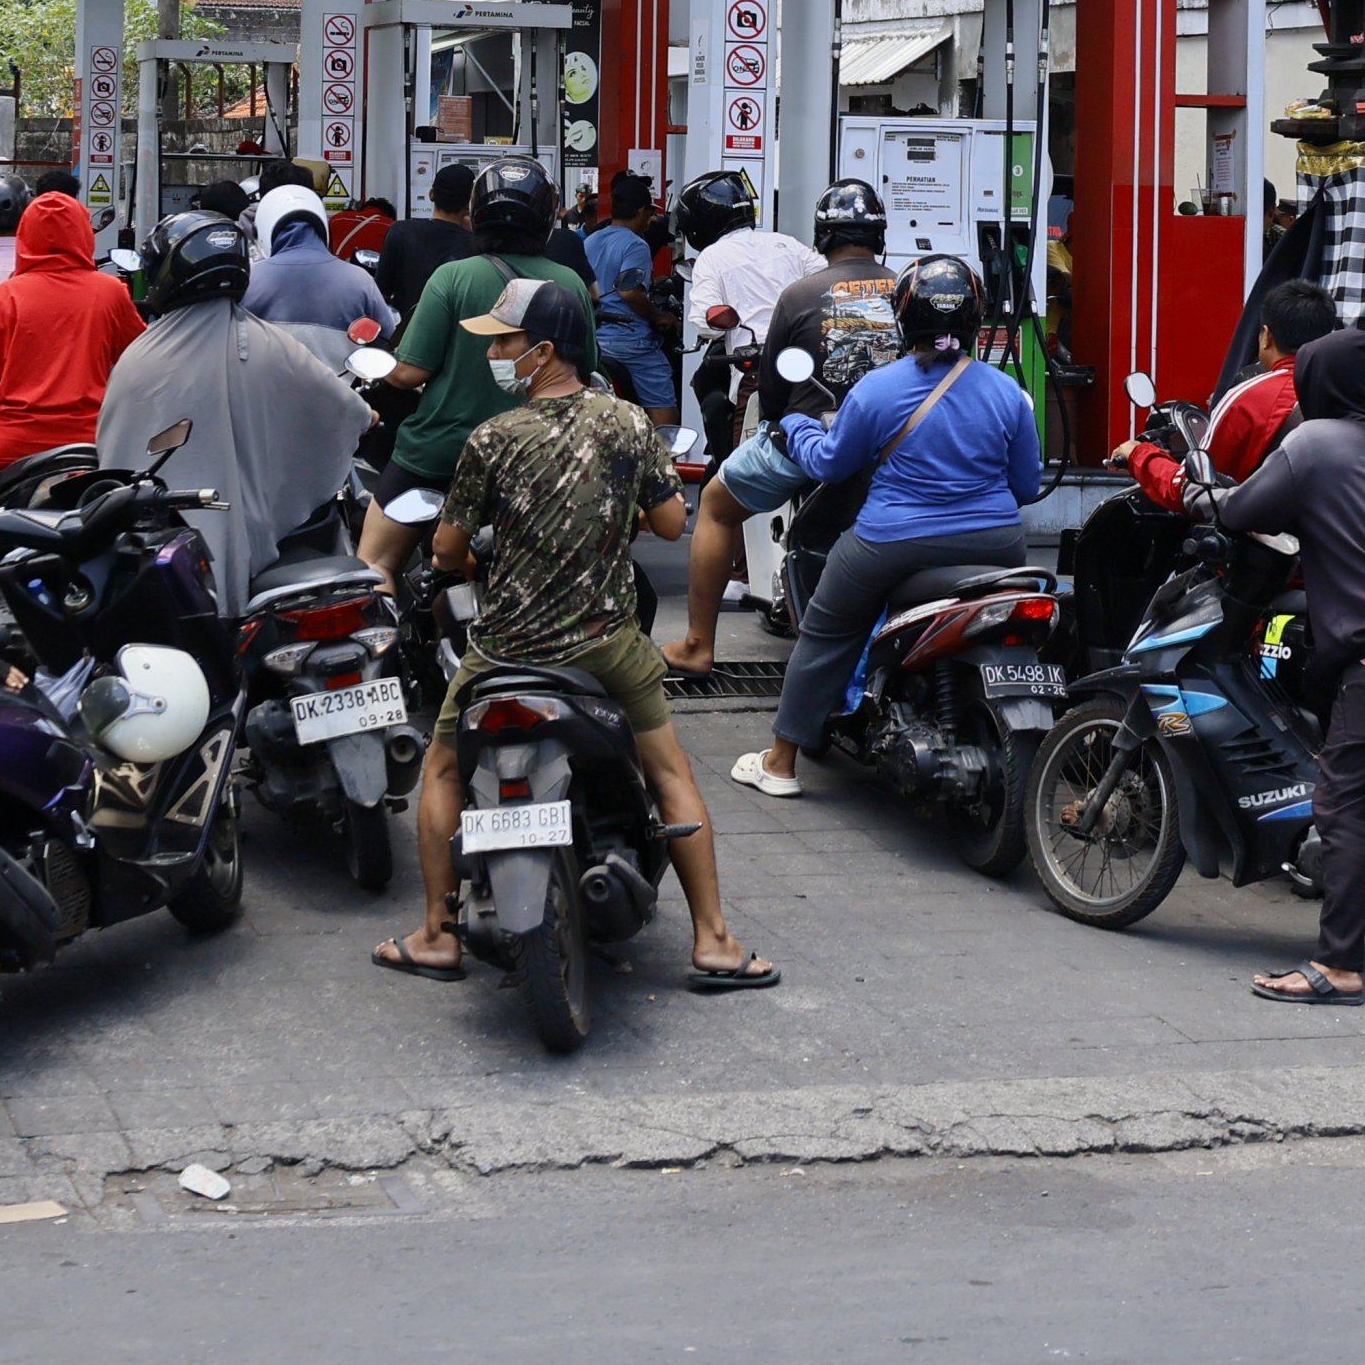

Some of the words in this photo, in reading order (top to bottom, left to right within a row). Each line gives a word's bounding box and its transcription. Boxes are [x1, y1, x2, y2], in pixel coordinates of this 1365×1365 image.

[475, 9, 514, 20] PERTAMINA
[211, 49, 244, 57] PERTAMINA
[1260, 642, 1292, 660] zzio
[985, 666, 1006, 683] DK
[1007, 665, 1045, 682] 5498
[1047, 666, 1063, 683] IK
[296, 698, 320, 721] DK
[323, 689, 365, 714] 2338
[370, 682, 400, 704] ABC
[1238, 784, 1306, 809] SUZUKI
[465, 815, 484, 833] DK
[491, 809, 531, 830] 6683
[538, 806, 567, 826] GBI
